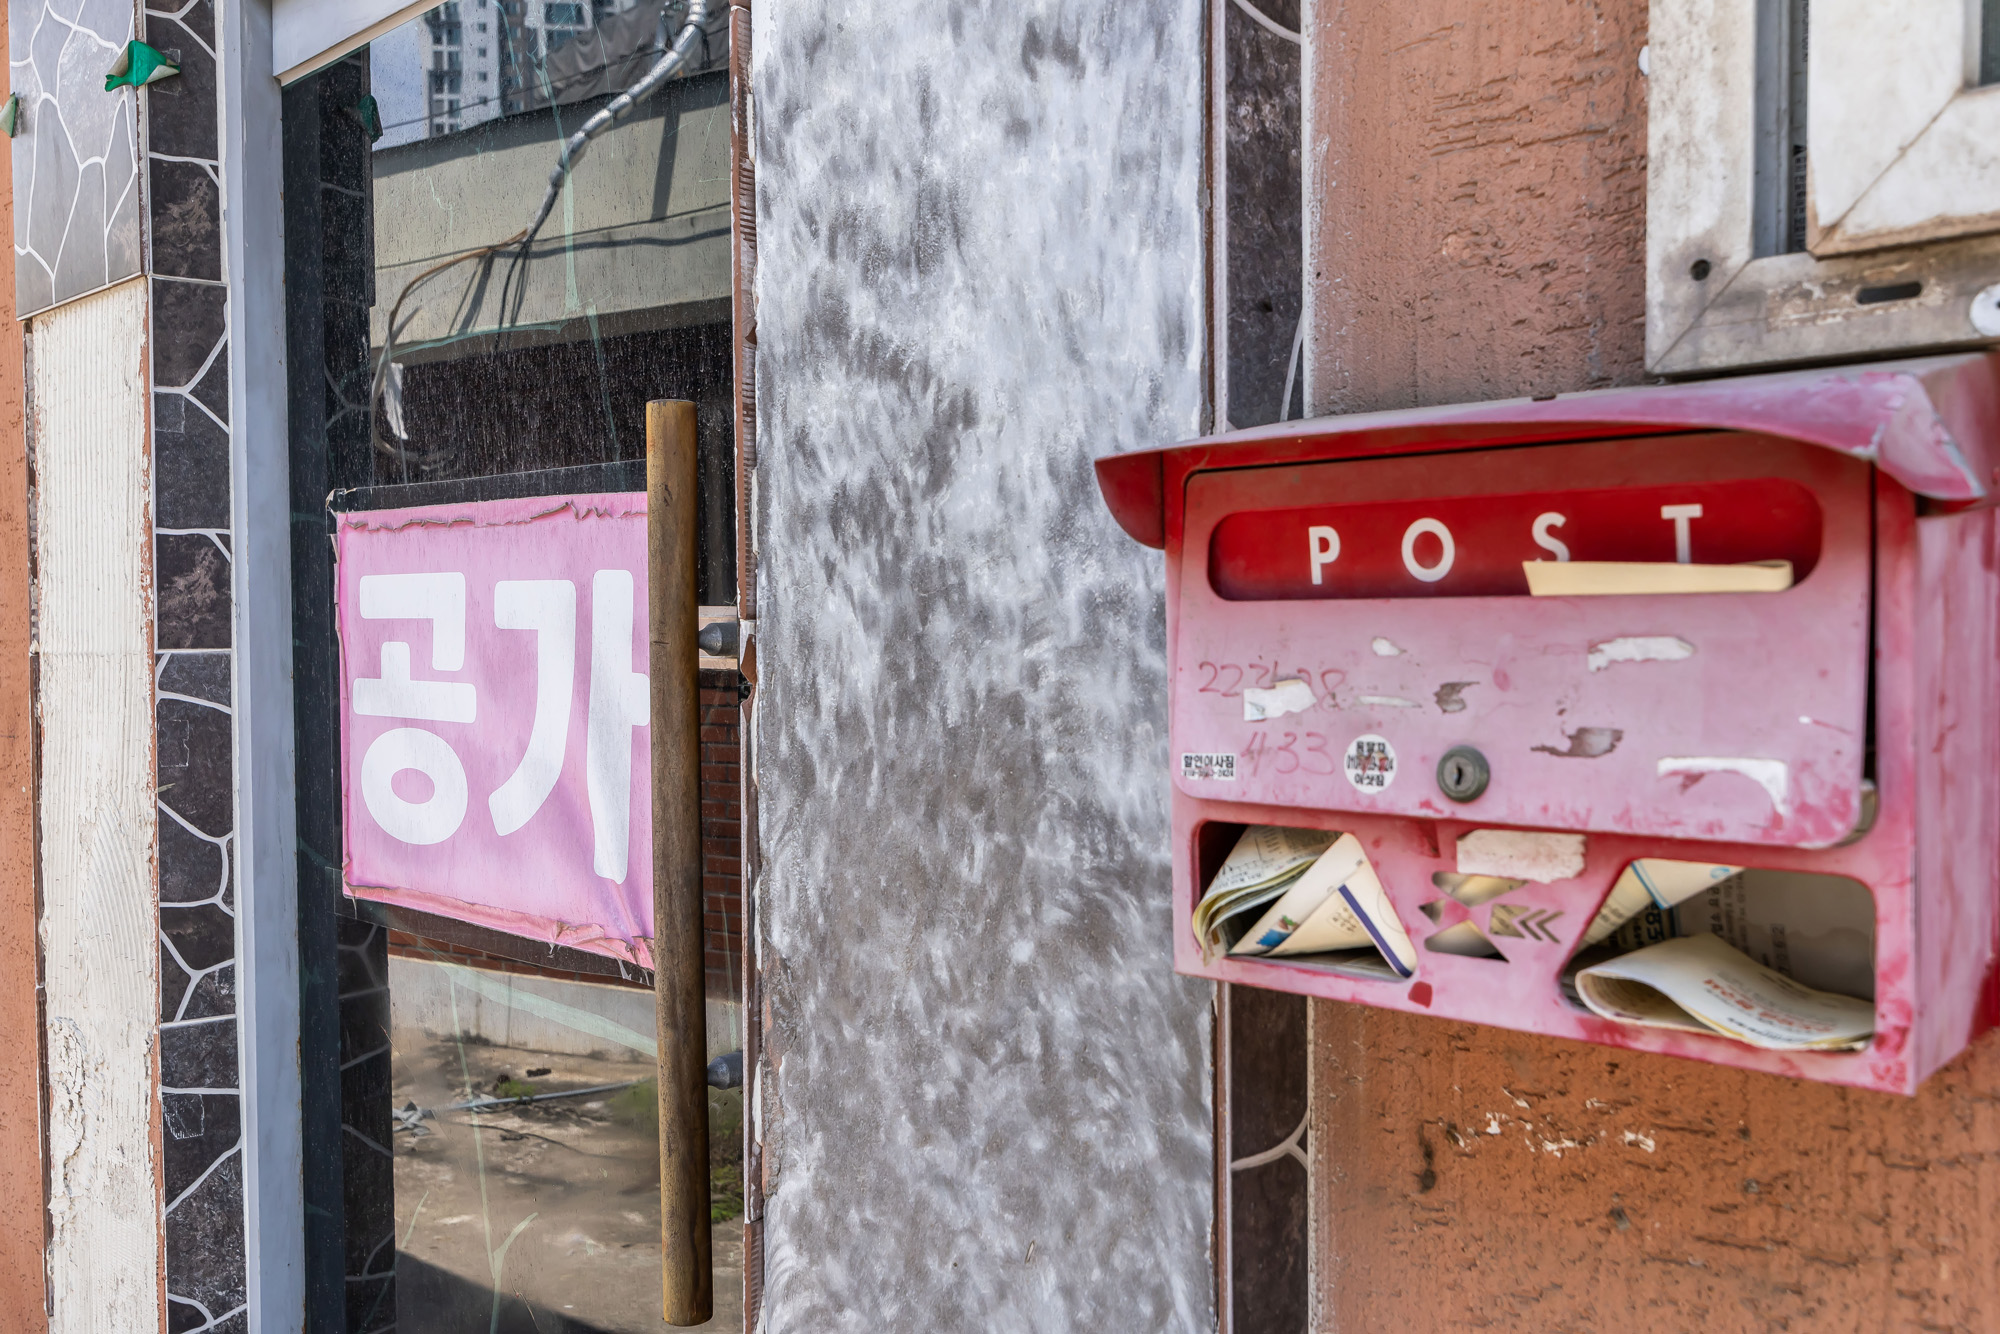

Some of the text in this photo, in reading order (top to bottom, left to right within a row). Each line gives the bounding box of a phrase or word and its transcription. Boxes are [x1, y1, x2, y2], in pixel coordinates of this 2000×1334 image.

[1308, 504, 1703, 585] POST
[352, 571, 650, 885] 공가
[1240, 731, 1336, 777] 433
[1184, 754, 1235, 768] 할인이사짐
